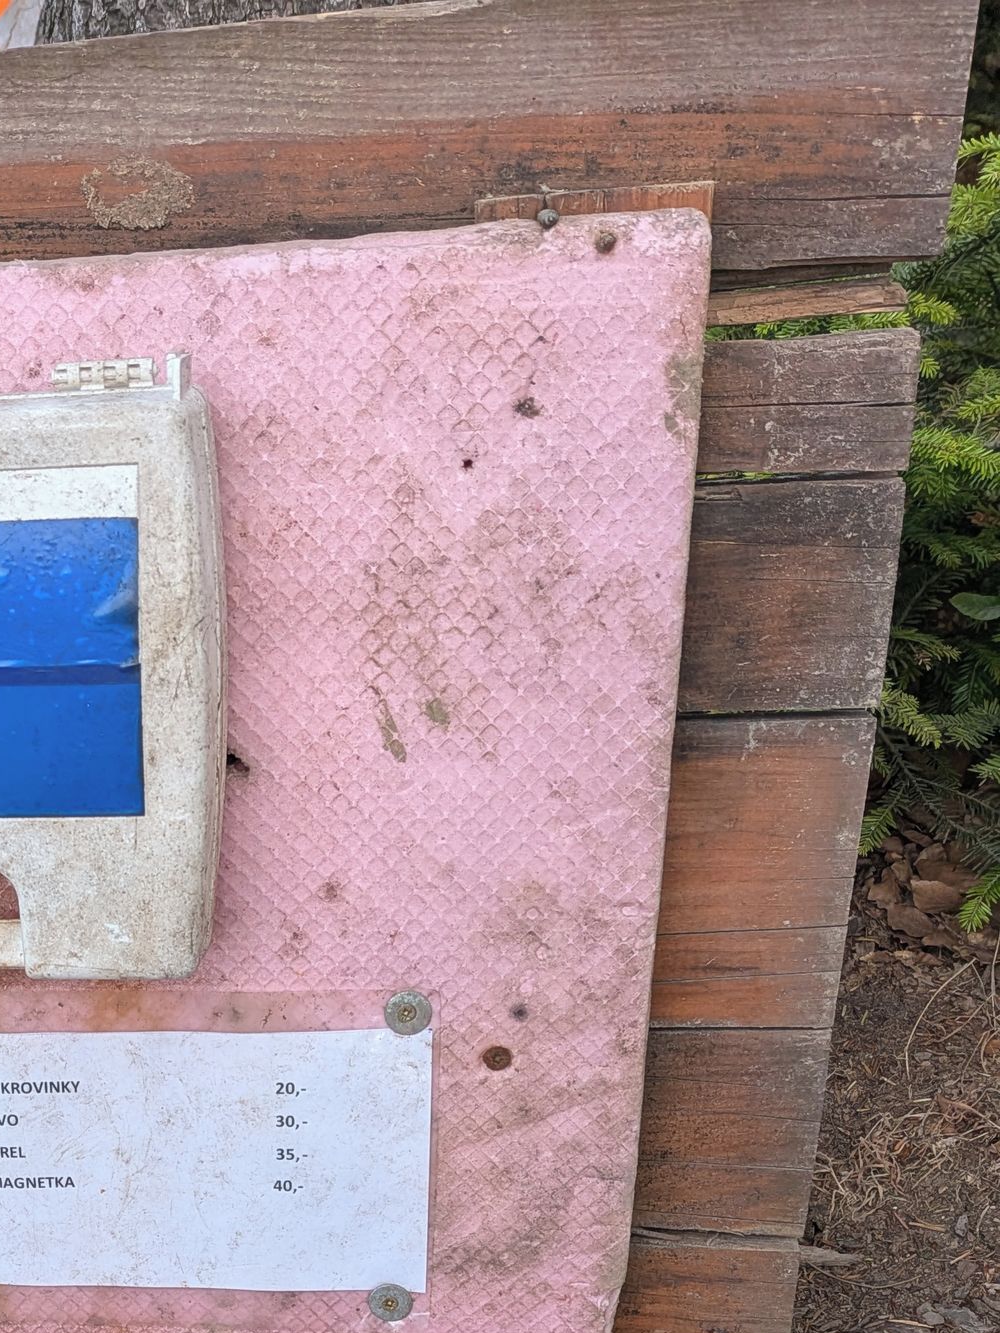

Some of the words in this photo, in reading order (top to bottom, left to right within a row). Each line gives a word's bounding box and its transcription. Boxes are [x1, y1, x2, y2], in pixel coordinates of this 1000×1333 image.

[275, 1082, 307, 1097] 20,-
[275, 1115, 308, 1130] 30,-
[276, 1148, 308, 1163] 35,-
[273, 1180, 304, 1194] 40,-
